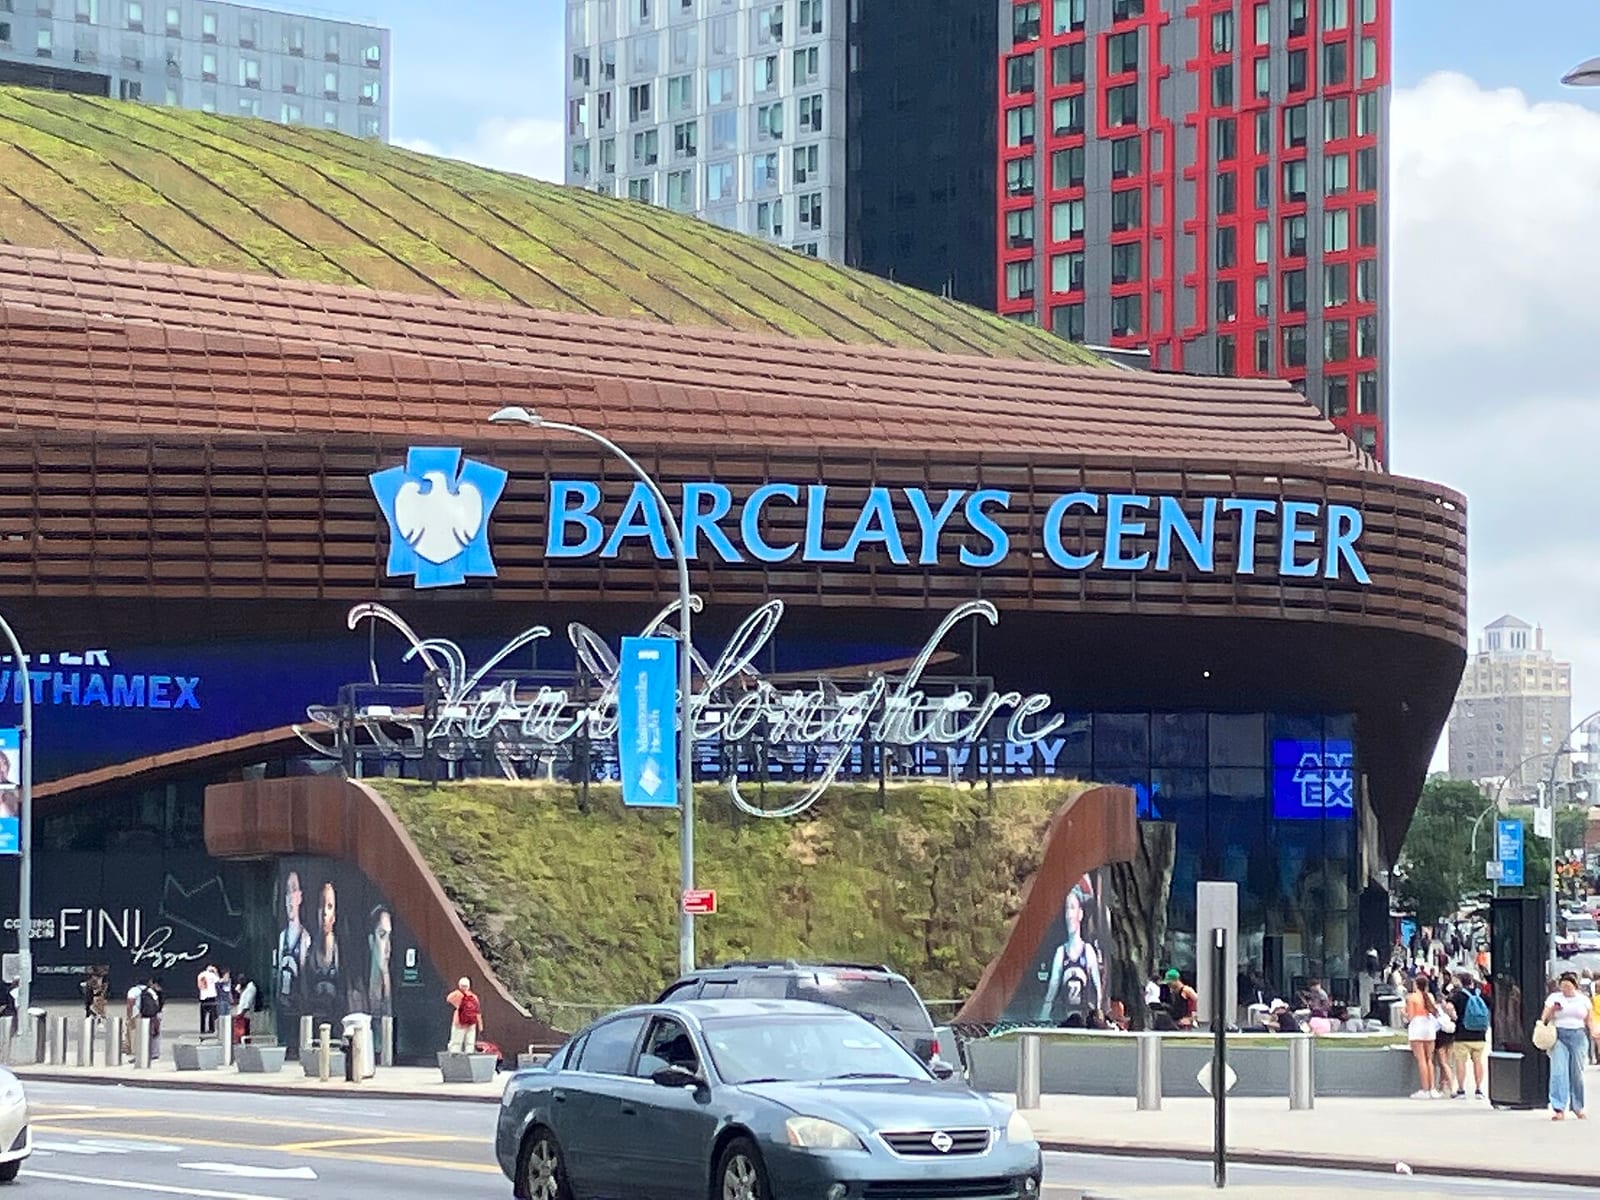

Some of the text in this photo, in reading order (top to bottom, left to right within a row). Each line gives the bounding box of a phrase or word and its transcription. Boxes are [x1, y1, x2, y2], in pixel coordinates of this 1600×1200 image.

[545, 480, 1371, 584] BARCLAYS CENTER
[61, 908, 141, 949] FINI
